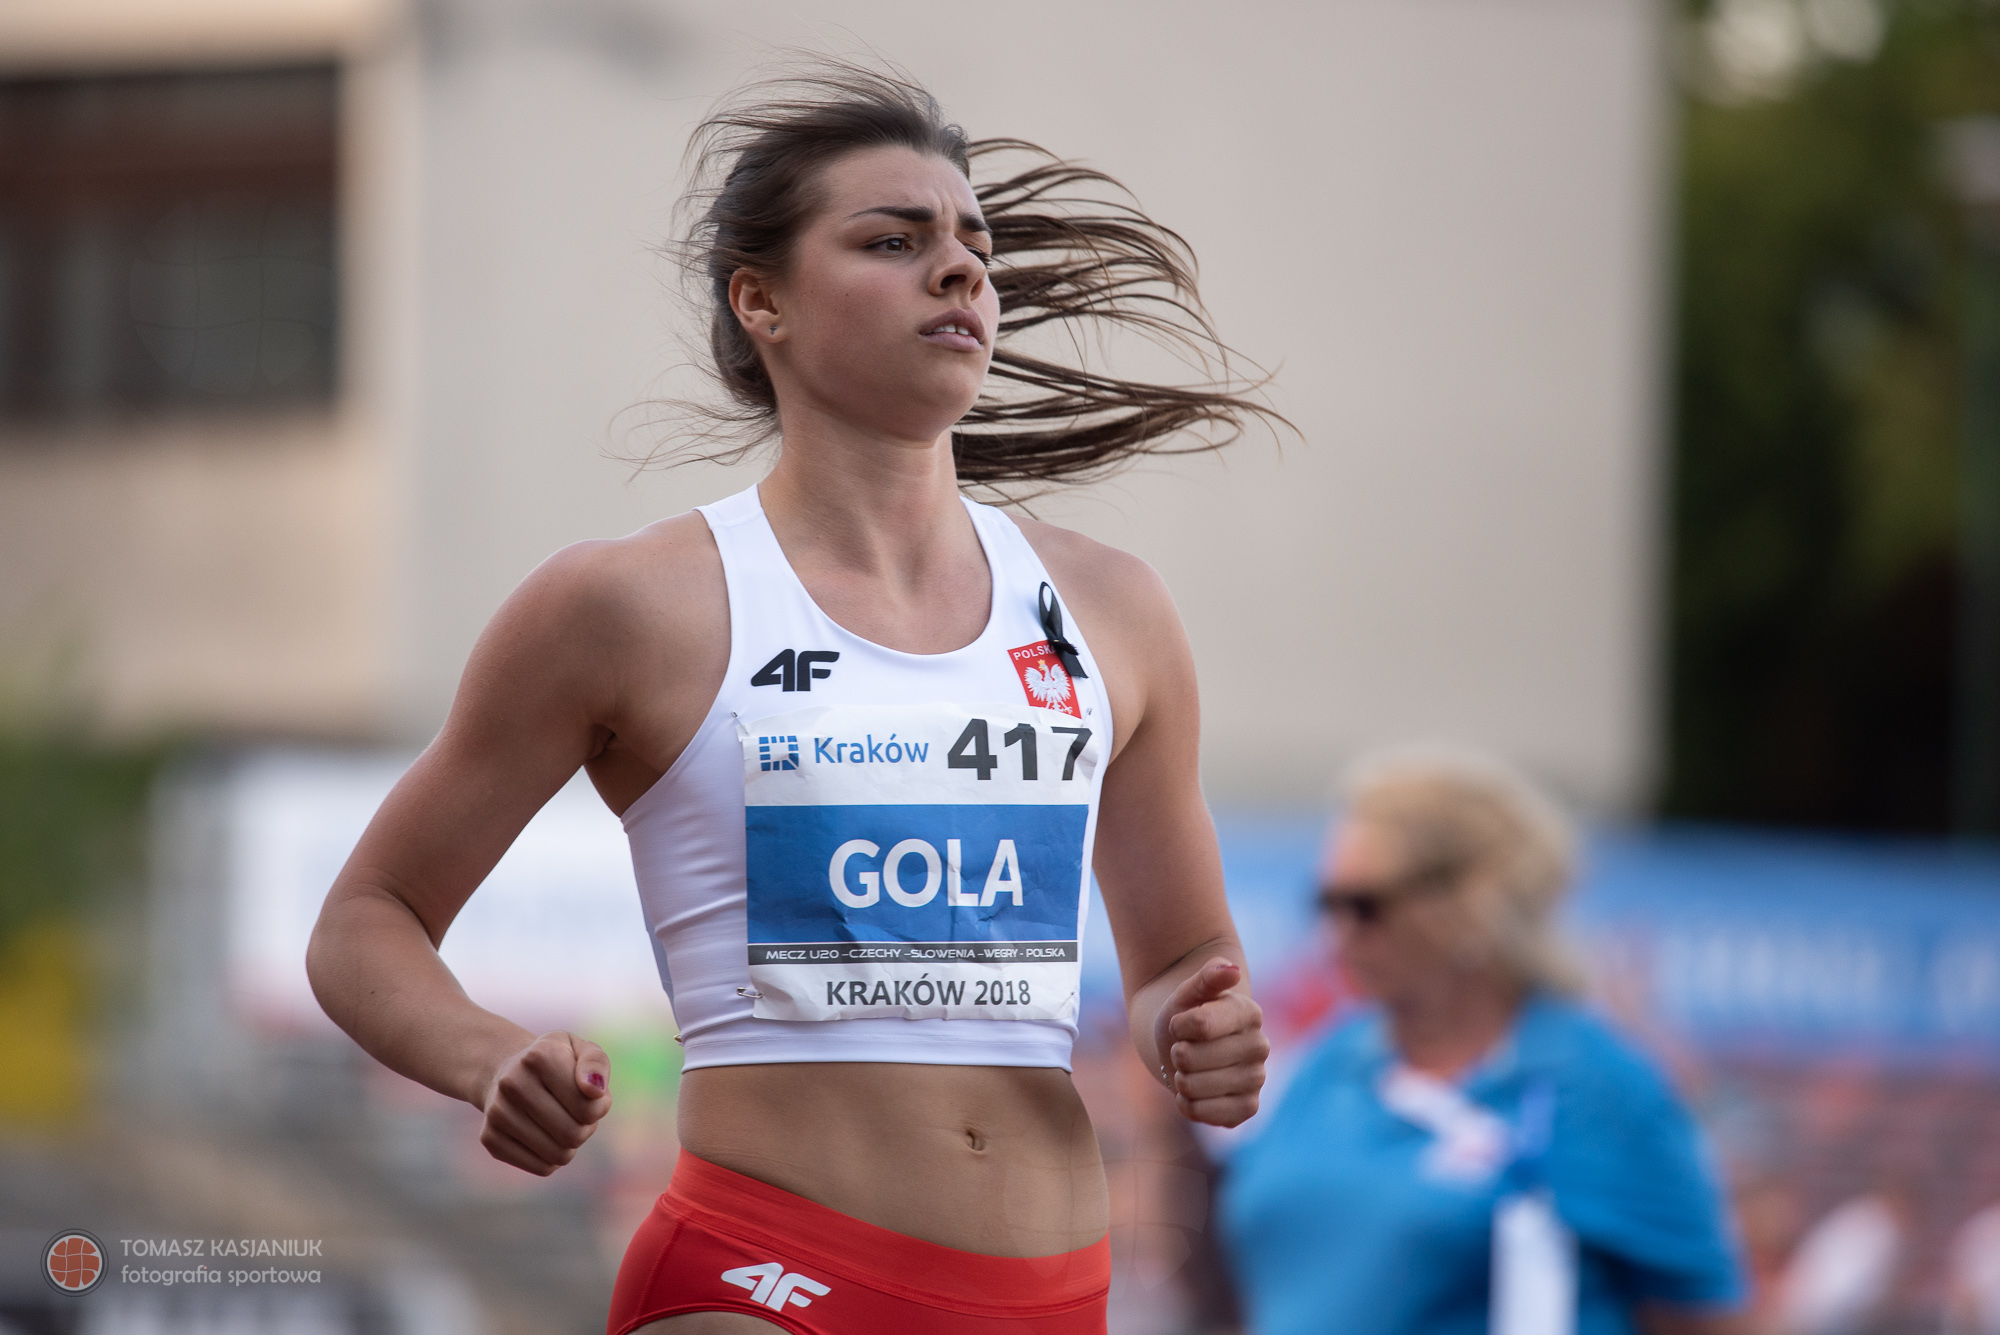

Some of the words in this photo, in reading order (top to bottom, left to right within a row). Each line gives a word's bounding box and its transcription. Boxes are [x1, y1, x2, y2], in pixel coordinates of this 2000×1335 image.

[750, 648, 840, 692] 4F
[814, 733, 929, 764] Kraków
[947, 718, 1093, 780] 417
[828, 838, 1024, 909] GOLA
[765, 950, 807, 960] MECZ
[809, 949, 840, 960] U20
[1026, 948, 1066, 958] POLSKA
[826, 973, 966, 1006] KRAKÓW
[974, 979, 1031, 1006] 2018
[720, 1262, 831, 1312] 4F
